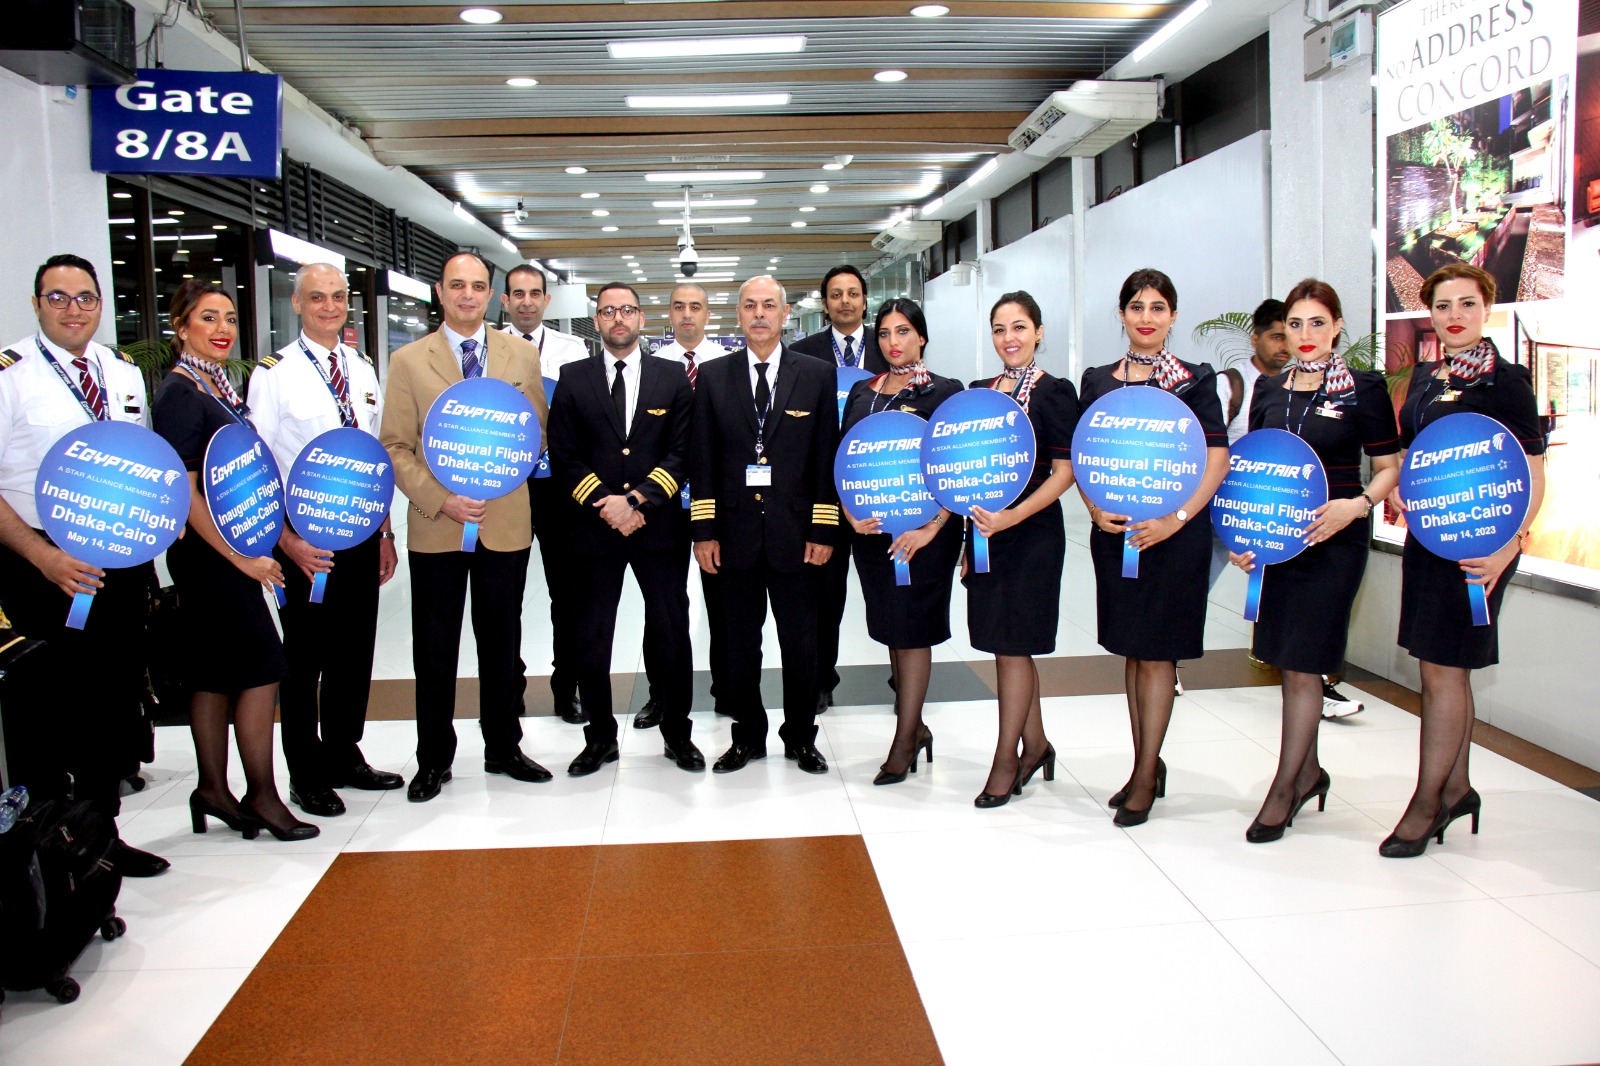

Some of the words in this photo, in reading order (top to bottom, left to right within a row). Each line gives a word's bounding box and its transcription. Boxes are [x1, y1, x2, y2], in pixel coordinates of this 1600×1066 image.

[1410, 0, 1534, 73] ADDRESS
[1398, 35, 1552, 122] CONCORD
[115, 80, 253, 114] Gate
[115, 128, 252, 162] 8/8A
[441, 399, 518, 425] EGYPTAIR
[1089, 412, 1176, 433] EGYPTAIR
[460, 426, 488, 435] ALLIANCE
[932, 416, 1004, 438] EGYPTAIR
[428, 436, 491, 456] Inaugural
[496, 447, 532, 463] Flight
[847, 438, 922, 455] EGYPTAIR
[953, 441, 979, 449] ALLIANCE
[1410, 440, 1491, 470] EGYPTAIR
[65, 441, 164, 482] EGYPTAIR
[211, 448, 256, 486] EGYPTAIR
[306, 448, 376, 475] EGYPTAIR
[437, 455, 519, 476] Dhaka-Cairo
[927, 456, 986, 475] Inaugural
[991, 451, 1029, 467] Flight
[1078, 453, 1148, 471] Inaugural
[1153, 459, 1197, 476] Flight
[1434, 472, 1465, 481] ALLIANCE
[1466, 464, 1495, 474] MEMBER
[65, 468, 85, 477] STAR
[87, 474, 124, 489] ALLIANCE
[125, 486, 157, 499] MEMBER
[322, 475, 347, 484] ALLIANCE
[349, 480, 371, 488] MEMBER
[452, 474, 468, 485] May
[470, 478, 480, 486] 14,
[483, 479, 501, 488] 2023
[842, 475, 904, 491] Inaugural
[909, 473, 924, 485] Fli
[938, 471, 1018, 490] Dhaka-Cairo
[1089, 471, 1182, 491] Dhaka-Cairo
[1243, 483, 1271, 491] ALLIANCE
[1272, 486, 1298, 494] MEMBER
[42, 481, 125, 516] Inaugural
[128, 506, 176, 531] Flight
[218, 492, 257, 526] Inaugural
[257, 478, 280, 500] Flight
[290, 484, 348, 506] Inaugural
[351, 496, 384, 513] Flight
[985, 490, 1003, 499] 2023
[1106, 492, 1123, 502] May
[1127, 494, 1139, 503] 14,
[1142, 495, 1162, 504] 2023
[1213, 495, 1274, 515] Inaugural
[1407, 487, 1474, 512] Inaugural
[1478, 479, 1523, 500] Flight
[51, 505, 156, 545] Dhaka-Cairo
[231, 500, 279, 539] Dhaka-Cairo
[297, 503, 370, 527] Dhaka-Cairo
[871, 510, 887, 518] May
[890, 509, 901, 517] 14,
[1421, 503, 1512, 528] Dhaka-Cairo
[246, 534, 257, 546] May
[257, 529, 265, 537] 14,
[265, 521, 275, 533] 2023
[308, 523, 323, 534] May
[325, 527, 334, 535] 14,
[336, 529, 353, 537] 2023
[1222, 514, 1303, 538] Dhaka-Cairo
[1440, 532, 1458, 542] May
[1460, 530, 1473, 539] 14,
[1475, 526, 1496, 536] 2023
[67, 531, 88, 545] May
[92, 538, 105, 550] 14,
[108, 542, 132, 555] 2023
[1235, 535, 1250, 546] May
[1253, 538, 1263, 548] 14,
[1266, 541, 1284, 550] 2023
